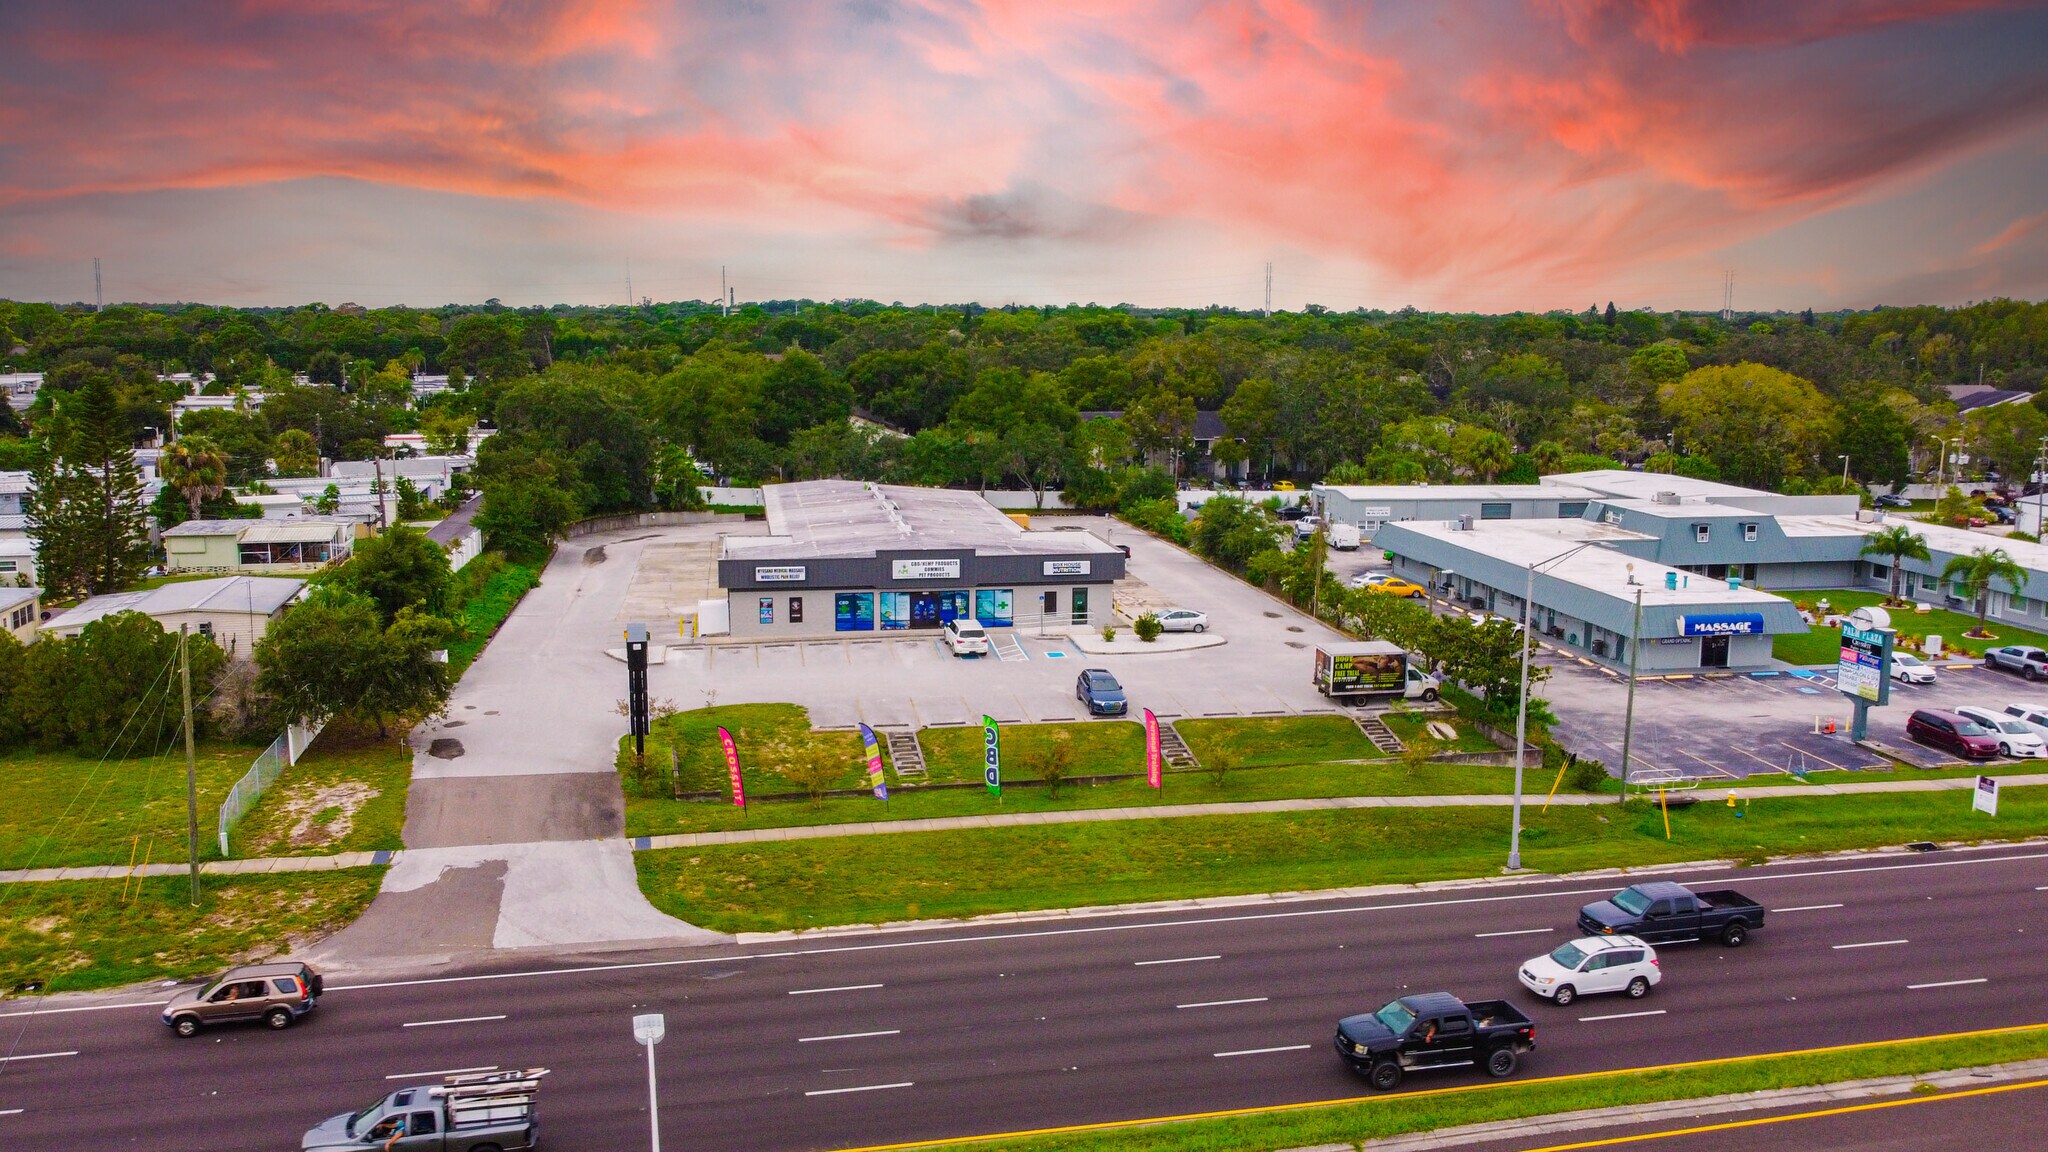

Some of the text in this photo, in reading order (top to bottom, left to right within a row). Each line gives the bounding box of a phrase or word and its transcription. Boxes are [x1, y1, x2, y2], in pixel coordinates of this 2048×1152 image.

[1695, 622, 1751, 632] MASSAGE
[1843, 625, 1883, 644] PALM PLAZA
[724, 738, 742, 801] CROSSFIT
